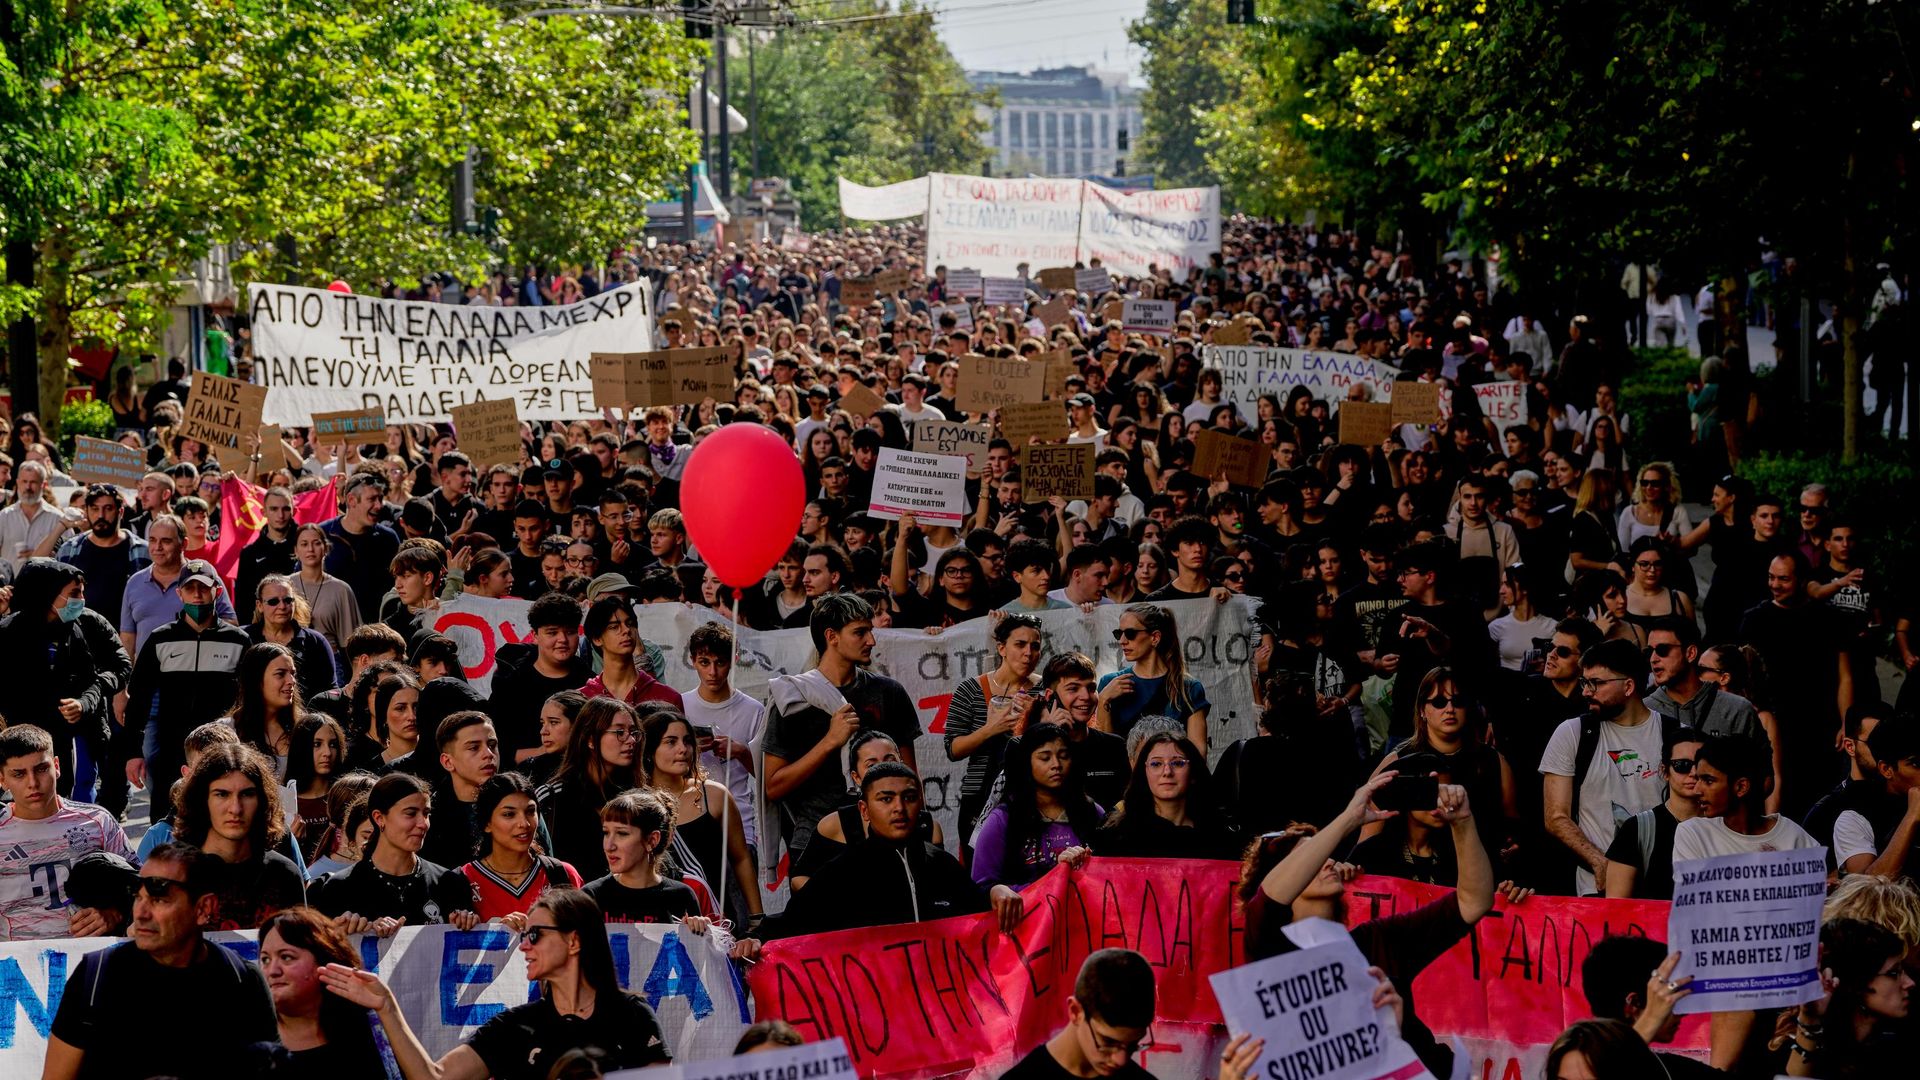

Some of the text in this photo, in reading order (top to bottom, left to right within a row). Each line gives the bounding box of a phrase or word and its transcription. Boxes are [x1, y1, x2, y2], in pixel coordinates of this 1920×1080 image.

[252, 286, 647, 339] ΑΠΟ ΤΗΝ ΕΛΛΑΔΑ ΜΕΧΡΙ
[340, 336, 512, 365] ΤΗ ΓΑΛΛΙΑ
[253, 355, 415, 387] ΠΑΛΕΥΟΥΜΕ
[431, 366, 473, 385] ΓΙΑ
[1211, 350, 1248, 368] ΑΠΟ
[1253, 351, 1292, 370] ΤΗΝ
[1303, 353, 1376, 377] ΕΛΛΑΔΑ
[1224, 370, 1247, 385] ΗΝ
[1257, 370, 1321, 386] ΓΑΛΛΙΑ
[201, 376, 241, 404] ΕΛΛΑΣ
[1224, 391, 1238, 404] ΙΑ
[190, 398, 242, 429] ΓΑΛΛΙΑ
[1489, 401, 1519, 420] LES
[920, 426, 987, 444] LE MONDE
[938, 440, 958, 451] EST
[885, 464, 906, 474] ΤΡΙΠΛΕΣ
[906, 468, 960, 480] ΠΑΝΕΛΛΑΔΙΚΕΣ!
[913, 457, 938, 466] ΣΚΕΨΗ
[1039, 464, 1085, 478] ΣΧΟΛΕΙΑ
[887, 483, 919, 494] ΚΑΤΑΡΓΗΣΗ
[920, 487, 934, 495] ΕΒΕ
[1025, 478, 1051, 488] ΜΗΝ
[884, 494, 946, 508] ΤΡΑΠΕΖΑΣ ΘΕΜΑΤΩΝ
[1682, 860, 1825, 886] ΝΑ ΚΑΛΥΦΘΟΥΝ ΕΔΩ ΚΑΙ ΤΩΡΑ
[1675, 893, 1696, 908] ΟΛΑ
[1699, 891, 1713, 905] ΤΑ
[1716, 888, 1750, 903] ΚΕΝΑ
[1691, 919, 1816, 945] ΚΑΜΙΑ ΣΥΓΧΩΝΕΥΣΗ
[1469, 911, 1647, 987] ΓΑΛΛ
[1695, 951, 1708, 968] 15
[1712, 947, 1782, 966] ΜΑΘΗΤΕΣ
[775, 953, 890, 1062] ΑΠΟ
[883, 928, 1011, 1038] ΤΗΝ
[1254, 961, 1349, 1020] ÉTUDIER
[1299, 1005, 1329, 1042] OU
[1267, 1023, 1380, 1080] SURVIVRE?
[801, 1058, 828, 1078] ΚΑΙ
